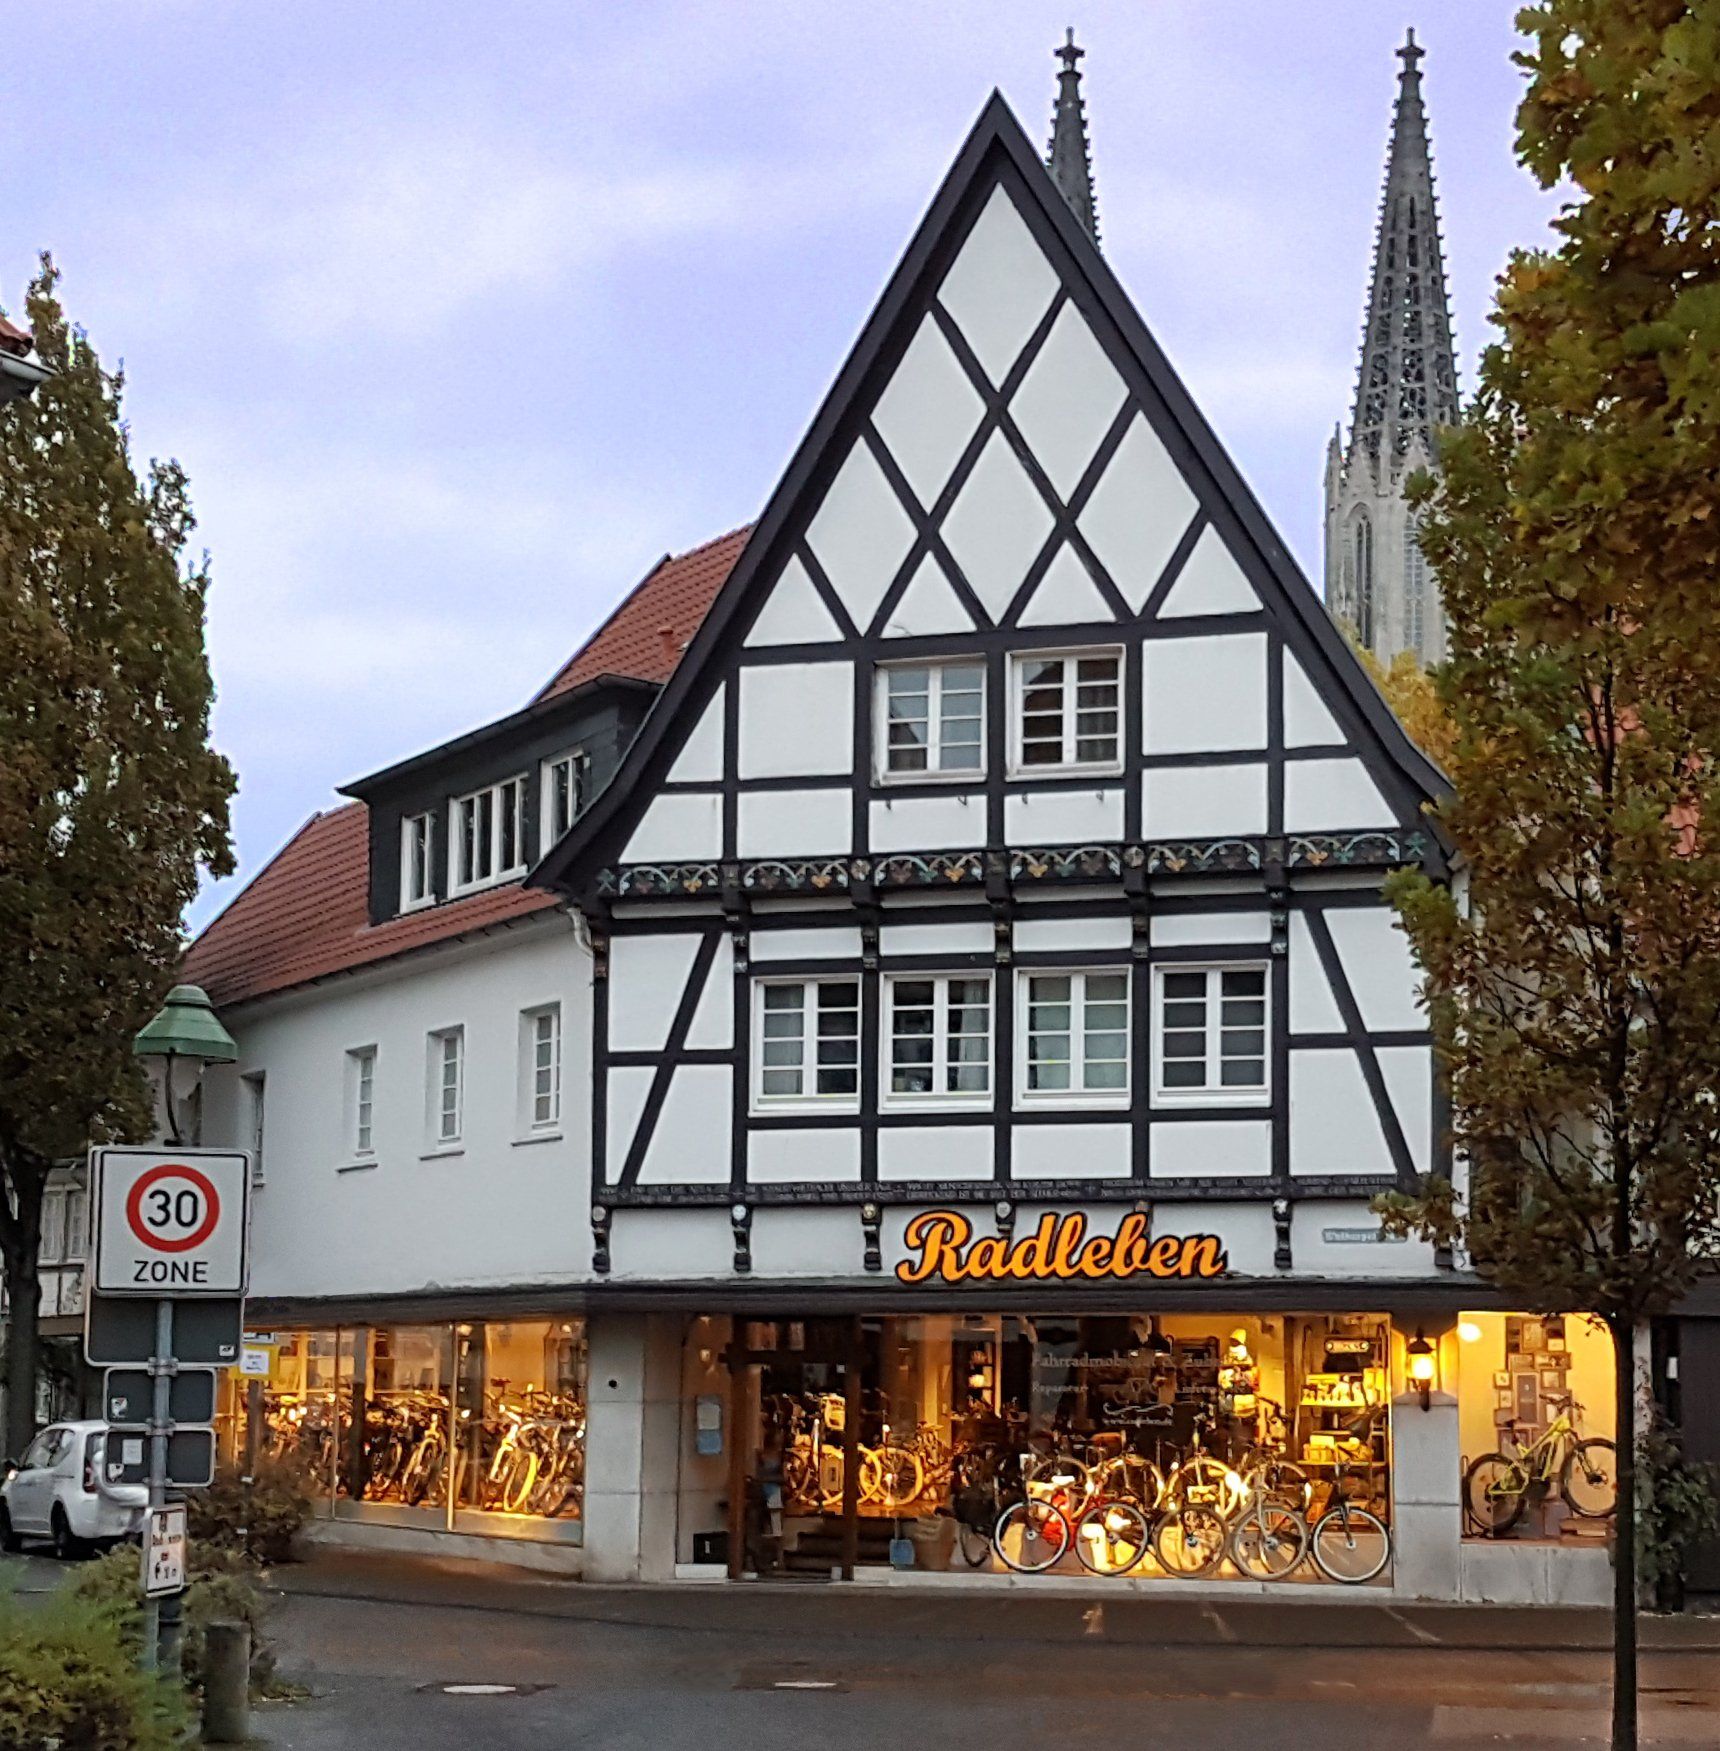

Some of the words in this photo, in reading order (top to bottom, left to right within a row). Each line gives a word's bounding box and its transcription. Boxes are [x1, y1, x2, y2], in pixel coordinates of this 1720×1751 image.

[147, 1189, 199, 1228] 30
[895, 1208, 1228, 1284] Radleben
[133, 1260, 209, 1283] ZONE
